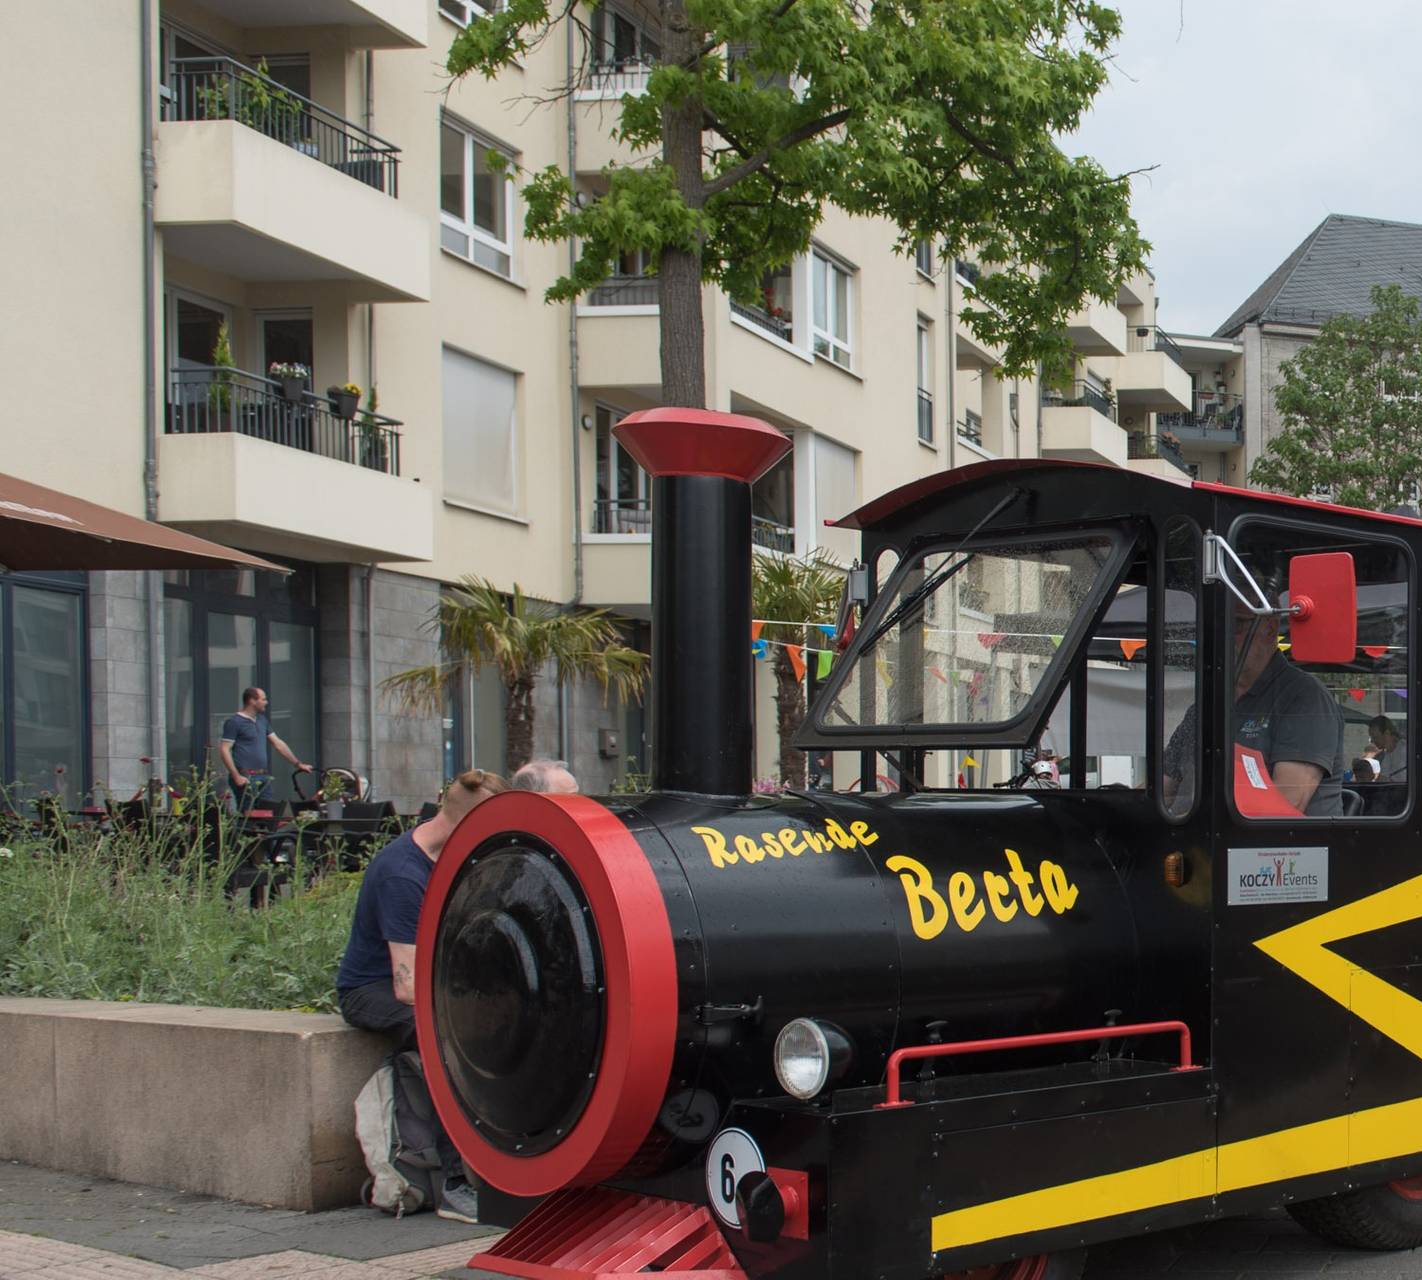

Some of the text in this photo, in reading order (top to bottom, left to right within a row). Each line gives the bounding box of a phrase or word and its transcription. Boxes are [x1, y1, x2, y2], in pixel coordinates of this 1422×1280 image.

[691, 818, 880, 868] Rasende
[886, 848, 1080, 941] Berta
[1240, 873, 1318, 887] KOCZY Events
[721, 1153, 735, 1204] 6
